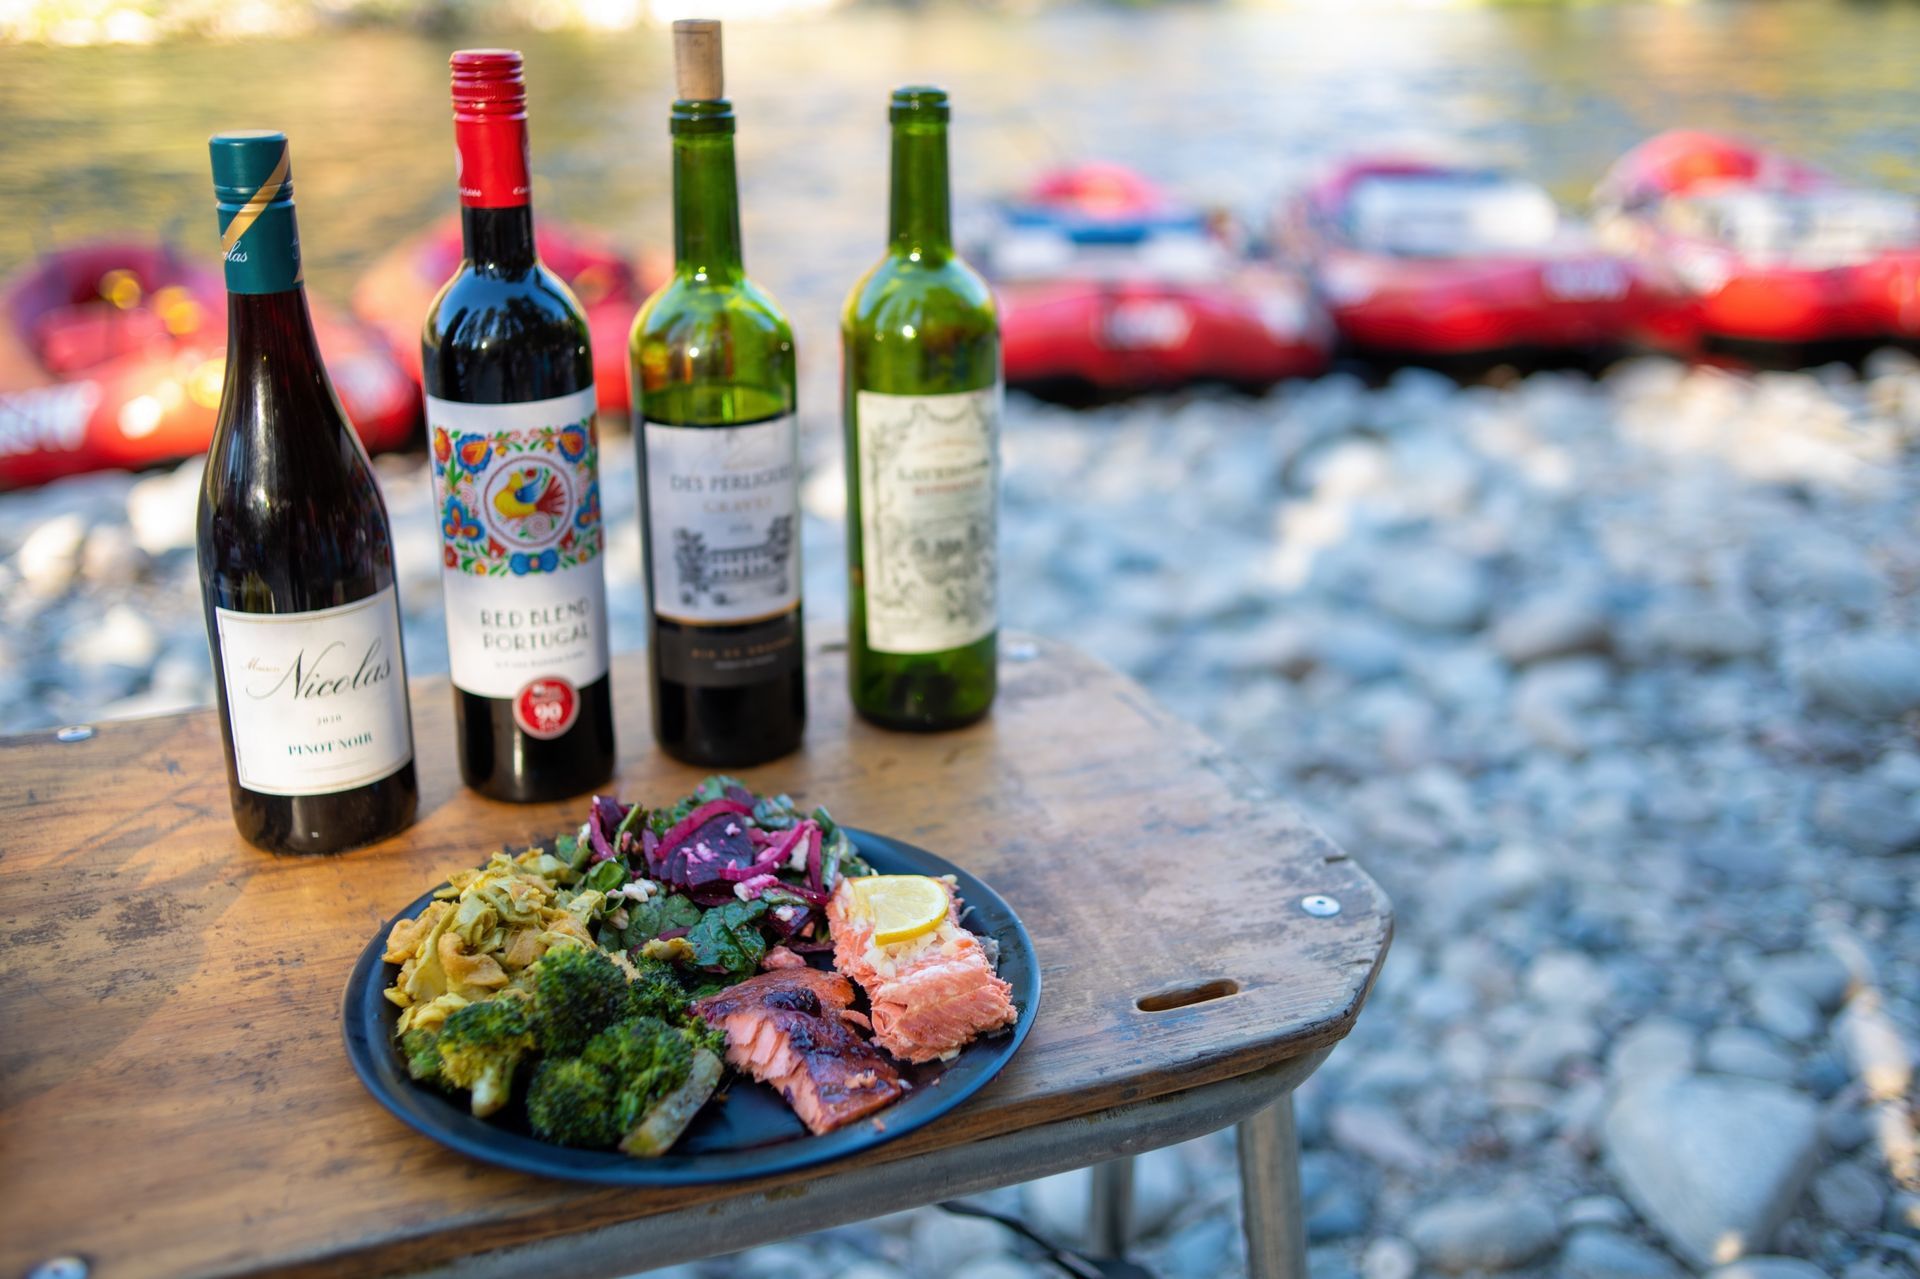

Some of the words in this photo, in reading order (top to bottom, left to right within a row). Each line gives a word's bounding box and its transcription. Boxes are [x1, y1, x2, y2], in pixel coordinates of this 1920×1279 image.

[480, 609, 523, 628] RED
[530, 598, 591, 627] BLEND
[483, 623, 590, 651] PORTUGAL
[246, 636, 391, 699] Nicolas
[534, 701, 563, 720] 90
[287, 742, 333, 756] PINOT
[338, 731, 373, 749] NOIR
